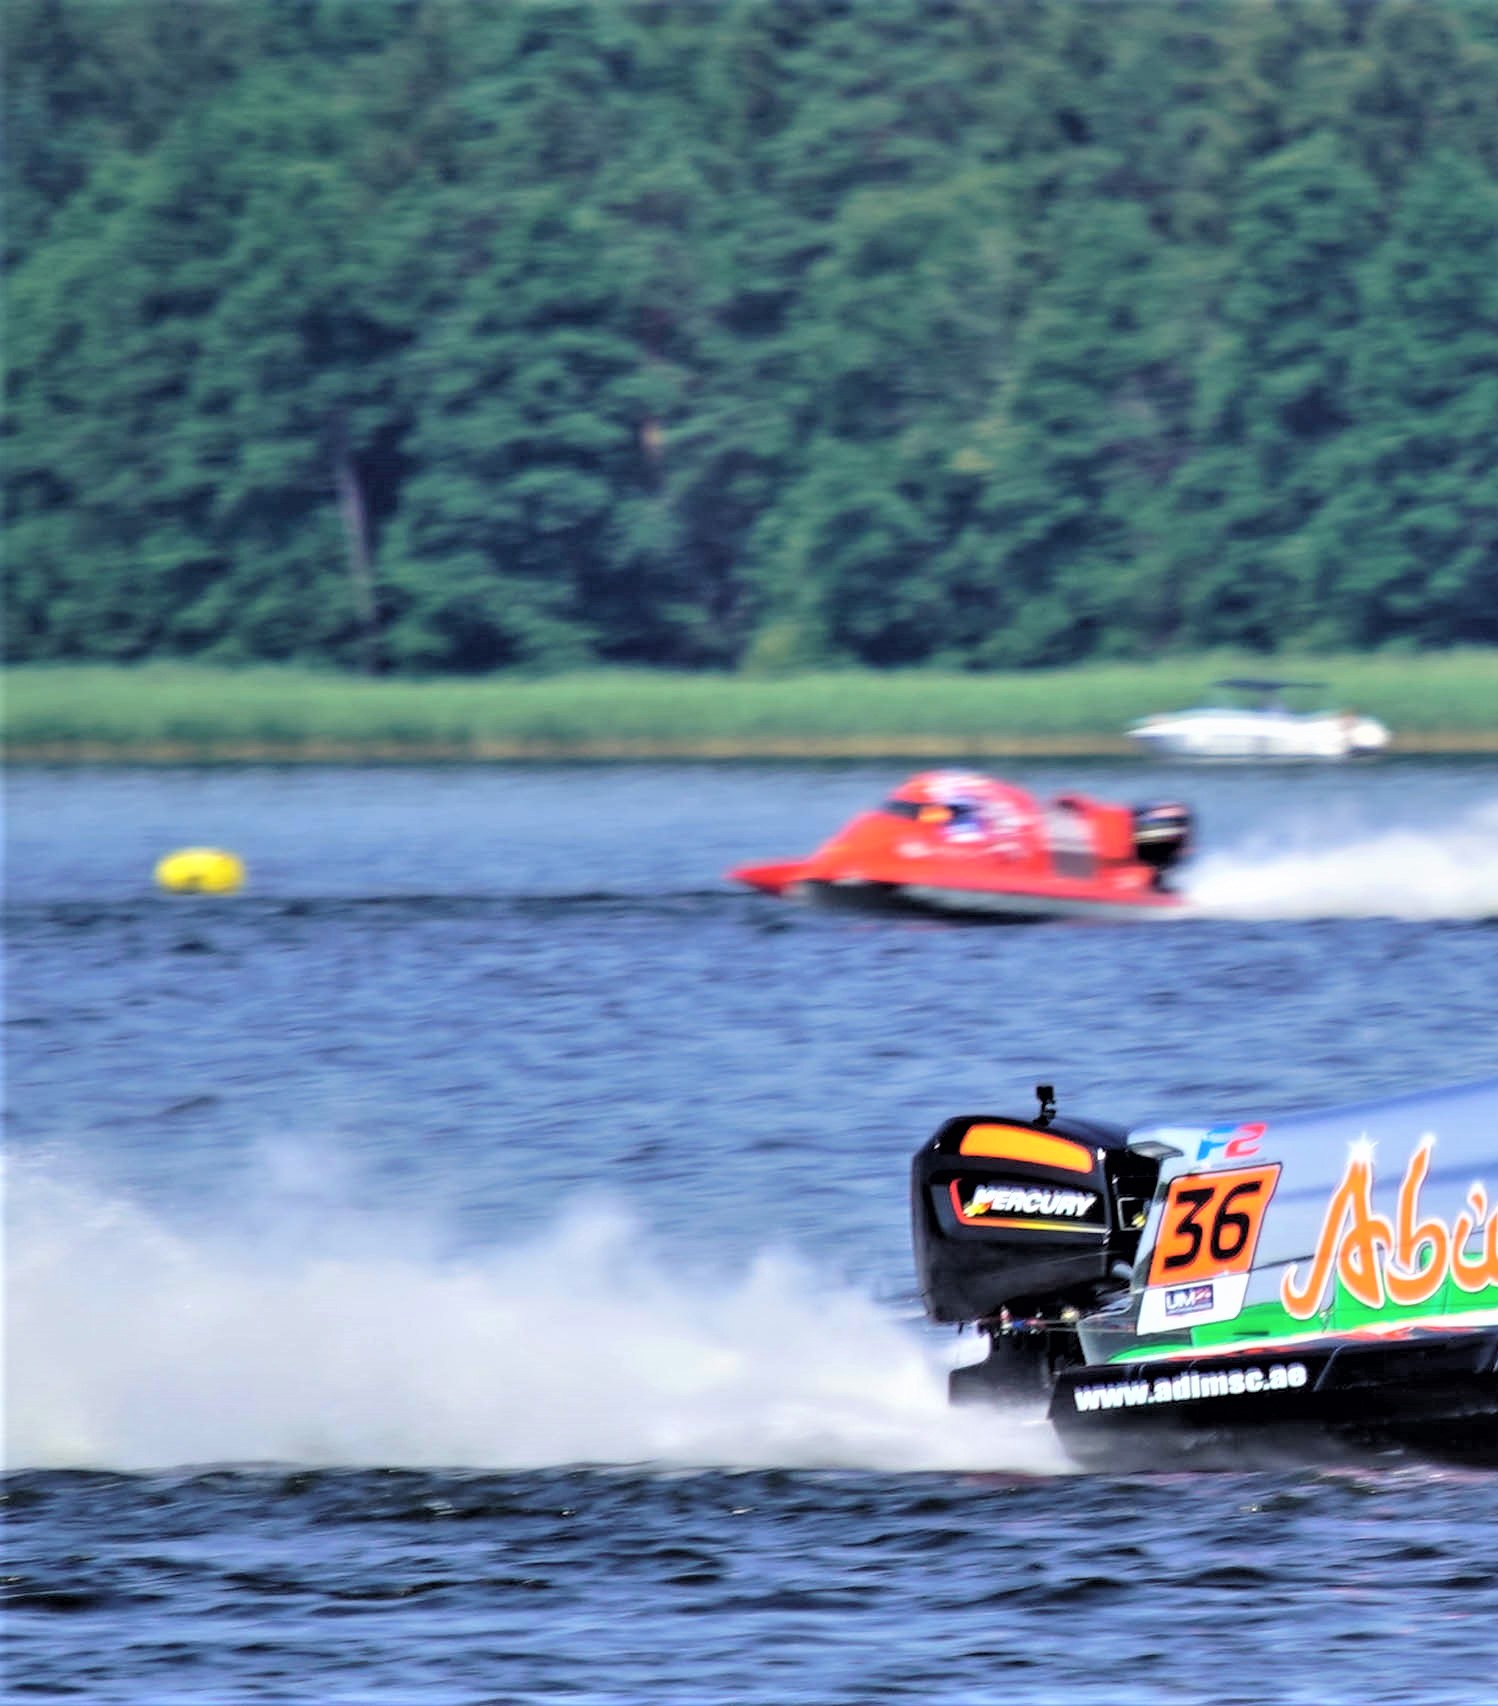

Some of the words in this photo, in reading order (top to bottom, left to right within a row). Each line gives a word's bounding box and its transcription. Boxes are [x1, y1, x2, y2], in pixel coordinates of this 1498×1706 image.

[1197, 1122, 1267, 1161] F2
[963, 1184, 1097, 1217] MERCURY
[1164, 1181, 1261, 1271] 36
